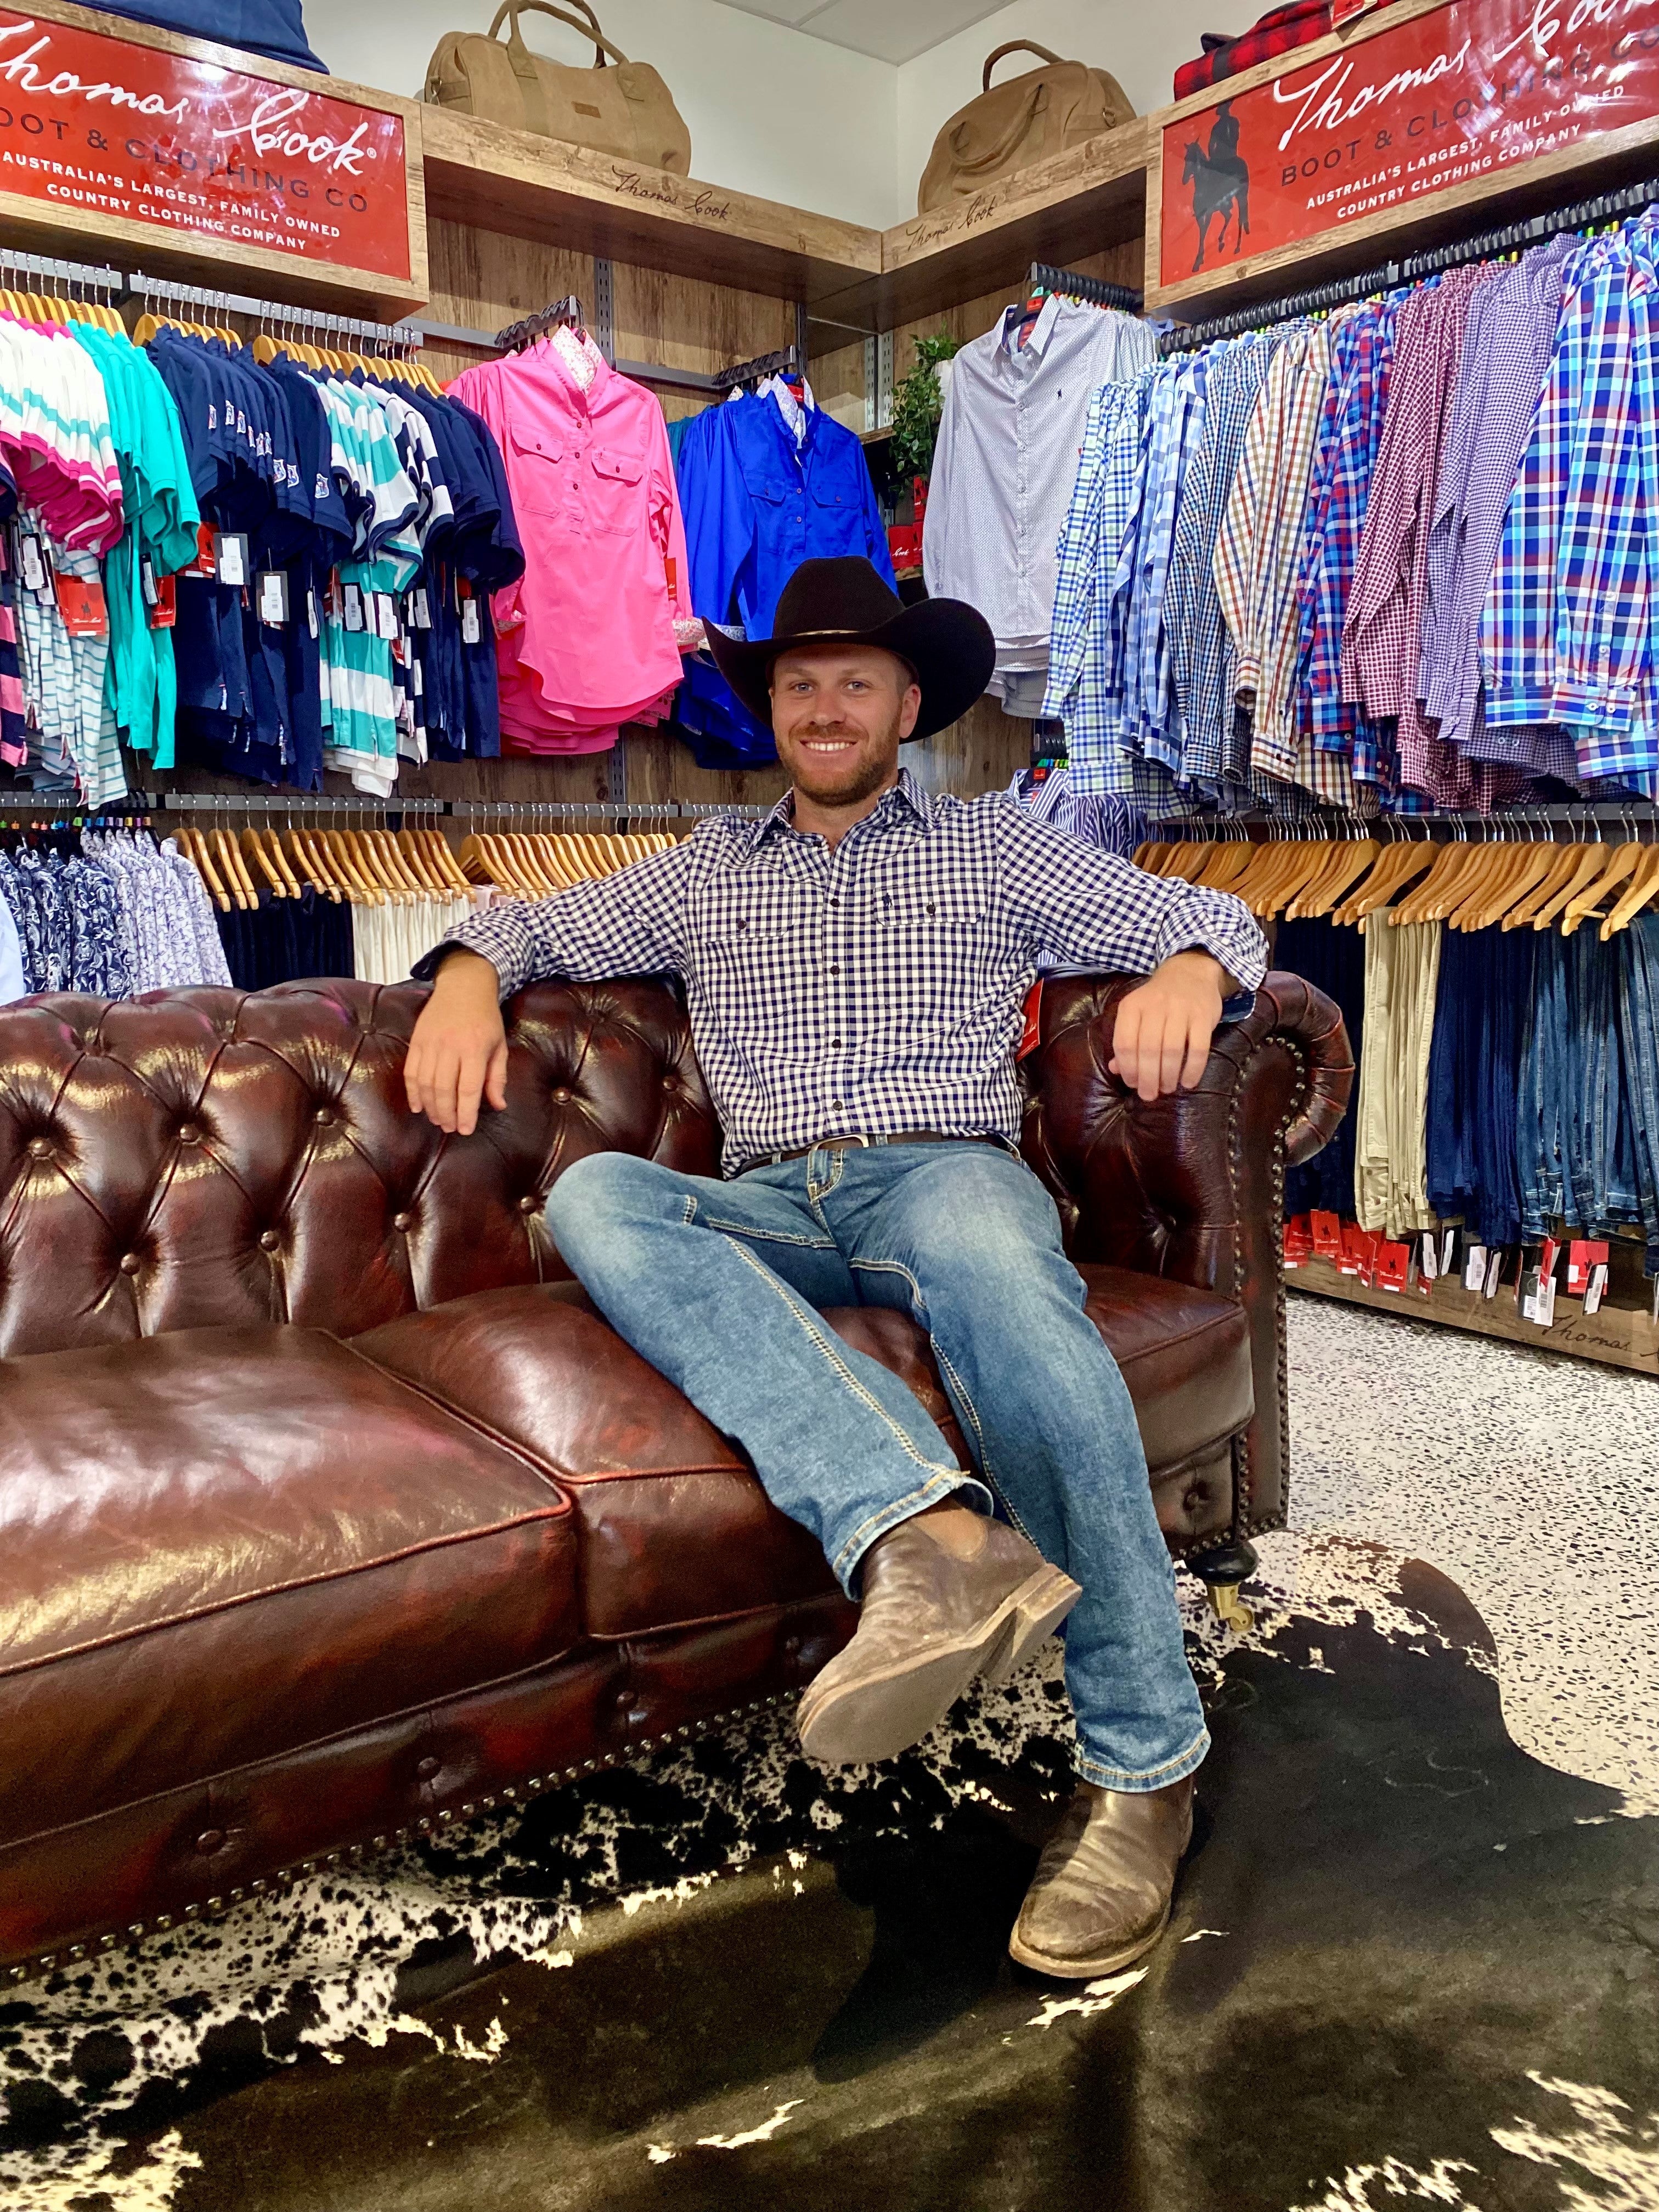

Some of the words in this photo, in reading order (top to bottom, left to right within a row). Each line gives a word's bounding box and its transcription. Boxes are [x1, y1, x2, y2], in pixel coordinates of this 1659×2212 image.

[1273, 38, 1471, 151] Thomas
[87, 129, 108, 151] &
[125, 138, 309, 198] CLOTHING
[325, 188, 368, 212] CO
[1282, 139, 1361, 187] BOOT
[1375, 129, 1392, 150] &
[1306, 165, 1401, 210] AUSTRALIA'S
[1407, 137, 1482, 172] LARGEST,
[1490, 110, 1553, 143] FAMILY
[1560, 85, 1624, 117] OED
[1337, 185, 1406, 218] COUNTRY
[1411, 155, 1492, 193] CLOTHING
[1498, 123, 1581, 162] COMPANY
[3, 151, 124, 188] AUSTRALIA'S
[131, 180, 214, 210] LARGEST,
[220, 201, 279, 223] FAMILY
[285, 216, 341, 238] OWNED
[47, 183, 130, 211] COUNTRY
[138, 204, 224, 232] CLOTHING
[230, 224, 306, 250] COMPANY
[612, 165, 678, 205] Thomas
[684, 190, 730, 220] Cook
[906, 223, 954, 252] Thomas
[958, 195, 996, 229] Cook
[1541, 1314, 1630, 1351] Thomas
